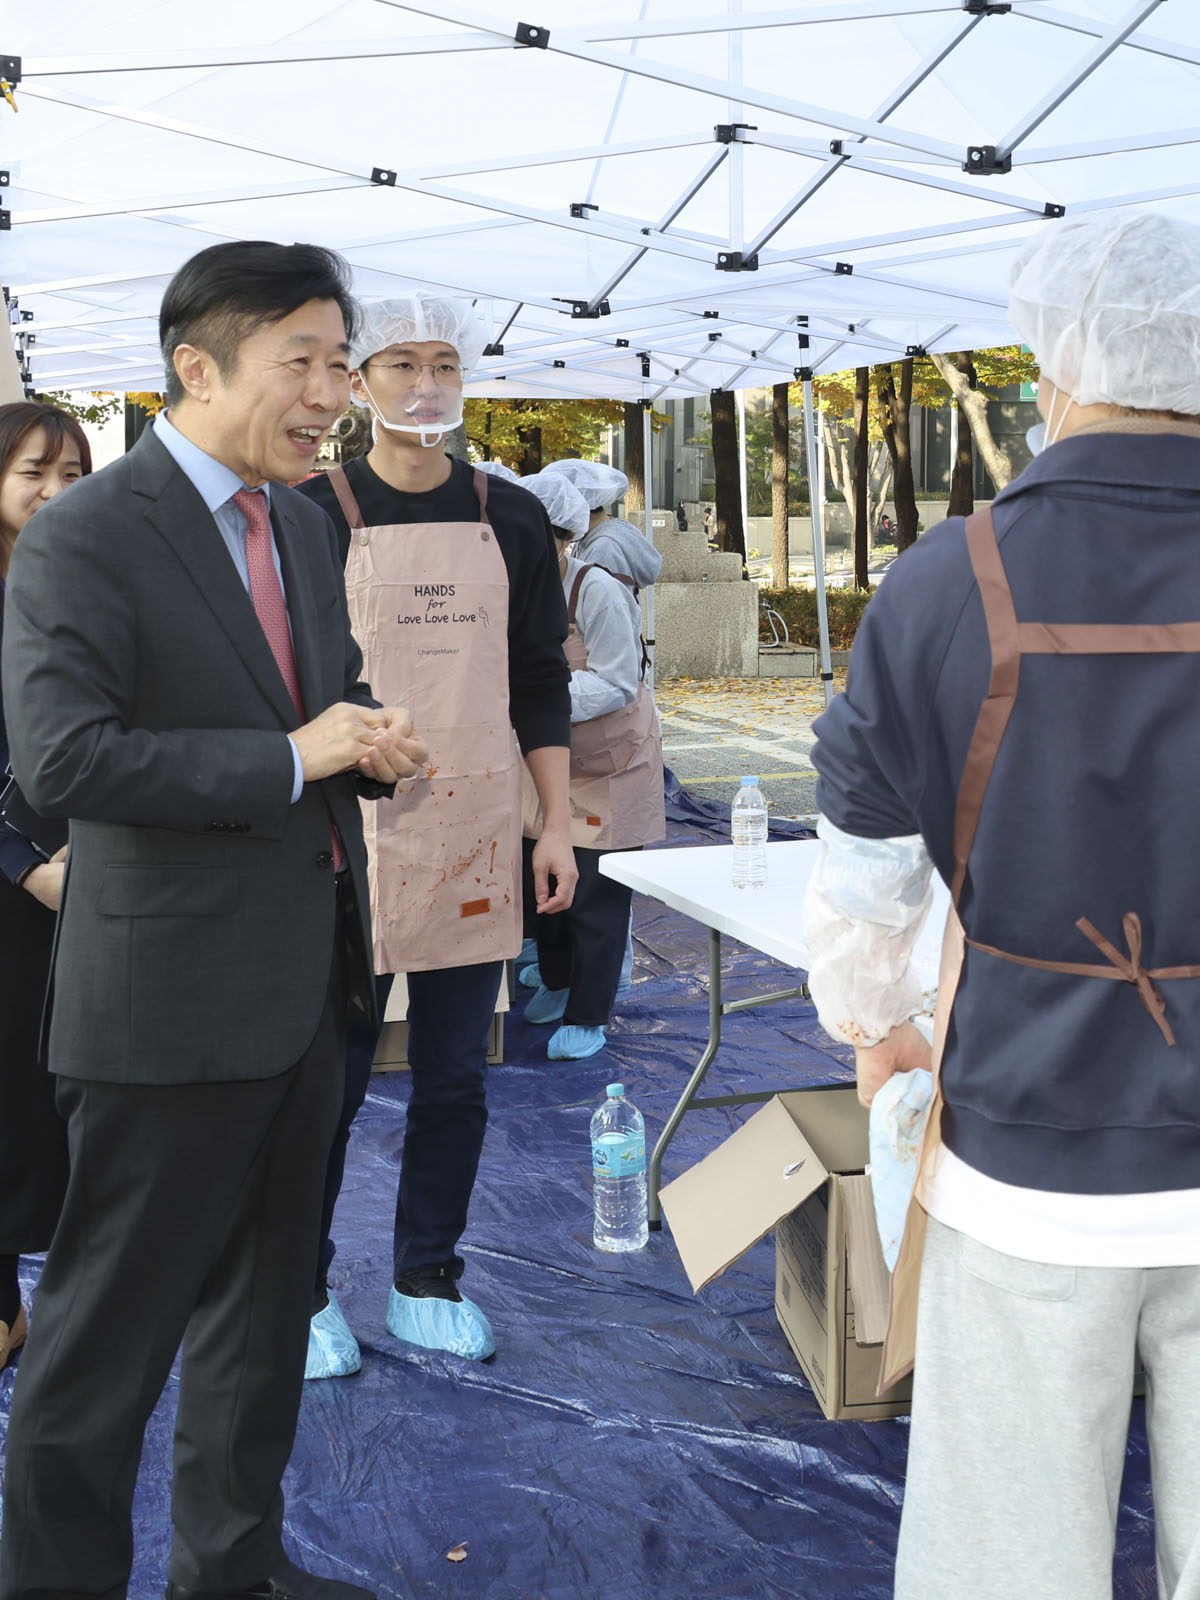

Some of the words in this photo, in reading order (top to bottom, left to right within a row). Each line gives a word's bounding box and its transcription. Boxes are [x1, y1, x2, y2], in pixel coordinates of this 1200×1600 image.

[414, 585, 456, 597] HANDS
[426, 599, 446, 612] for
[397, 613, 422, 625] Love
[424, 613, 449, 624] Love
[452, 612, 477, 624] Love
[417, 648, 460, 656] ChangeMaker
